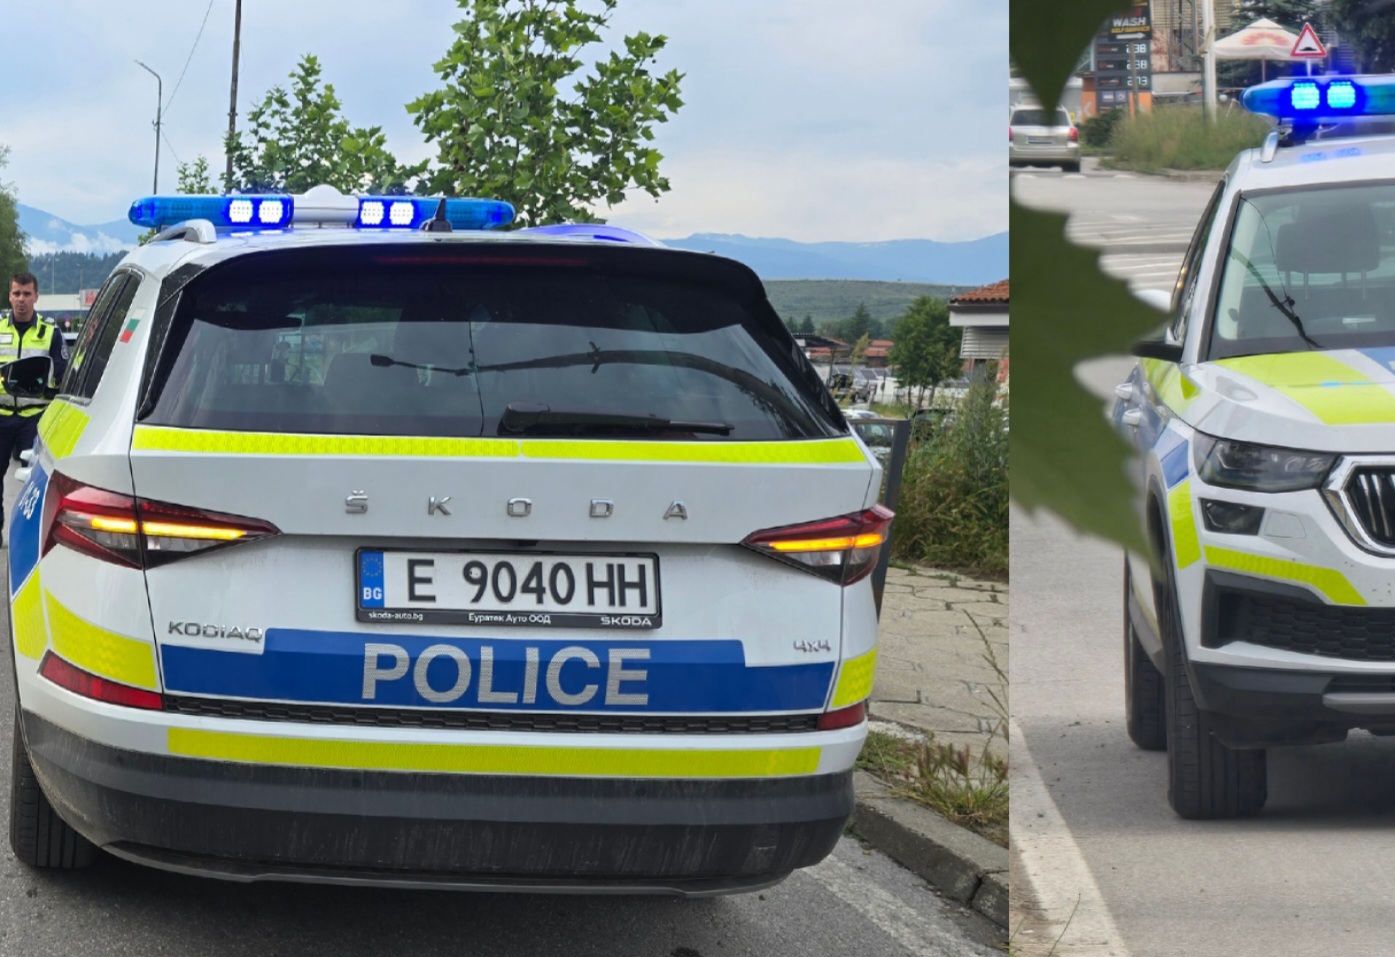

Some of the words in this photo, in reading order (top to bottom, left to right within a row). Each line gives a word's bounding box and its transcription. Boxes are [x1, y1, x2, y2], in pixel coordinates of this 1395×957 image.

[1112, 16, 1147, 27] WASH
[363, 587, 383, 601] BG
[407, 559, 436, 602] E
[463, 560, 575, 606] 9040
[586, 562, 647, 608] HH
[168, 621, 263, 643] KODIAQ
[362, 643, 651, 706] POLICE
